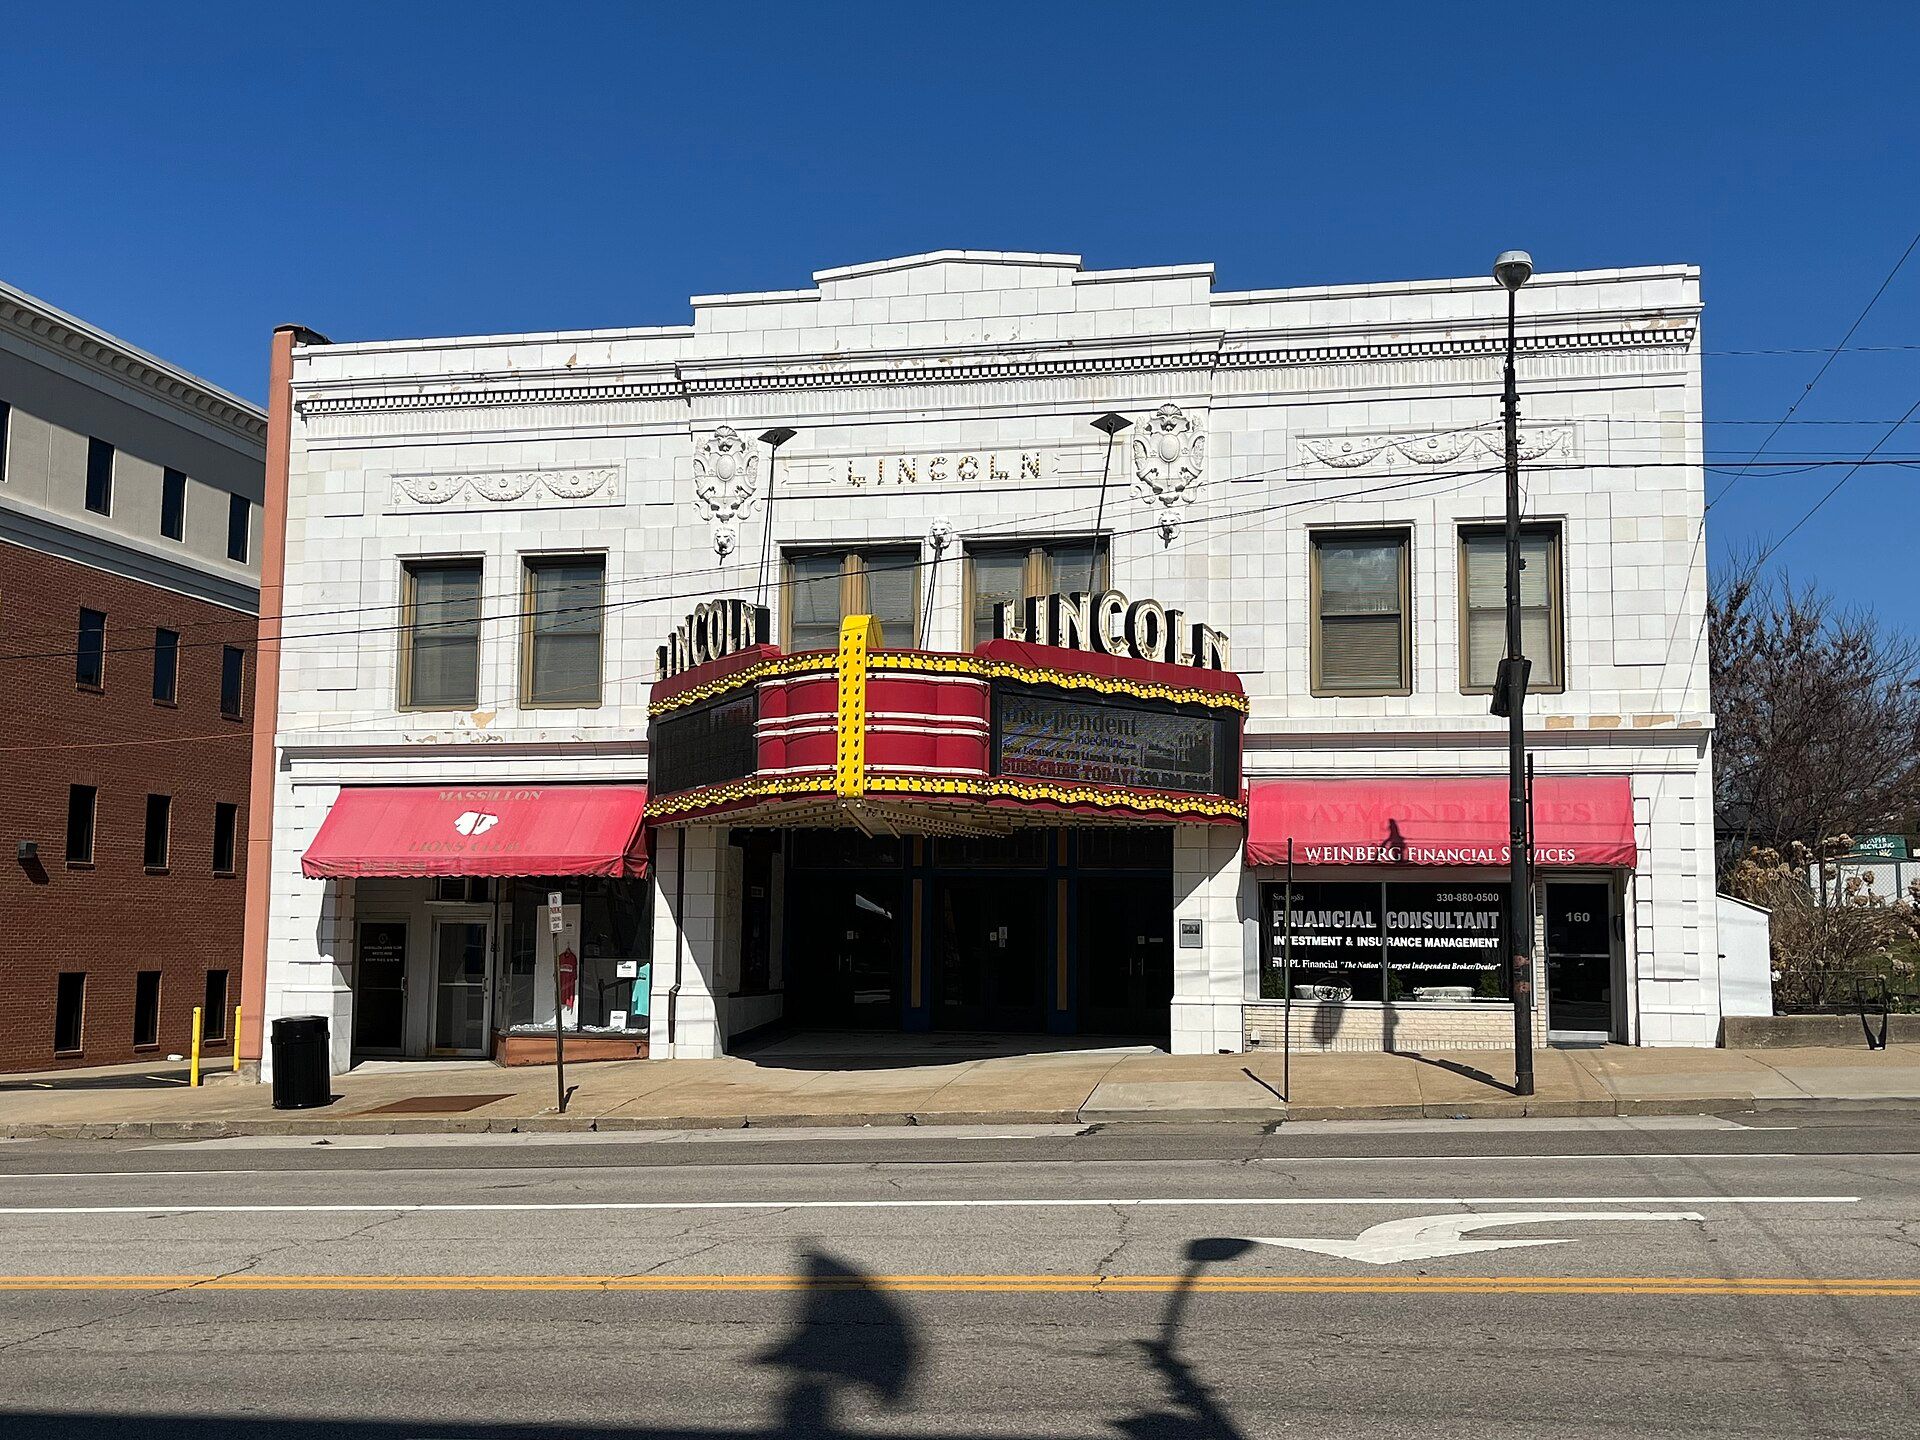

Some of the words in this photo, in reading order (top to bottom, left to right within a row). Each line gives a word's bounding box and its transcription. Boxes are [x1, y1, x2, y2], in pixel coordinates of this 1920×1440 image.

[847, 452, 1042, 487] LINCOLN
[993, 589, 1229, 672] LINCOLN
[655, 599, 769, 681] LINCOLN
[1003, 757, 1080, 779] SUBSCRIBE
[1084, 764, 1135, 785] TODAY!
[438, 790, 543, 801] MASSILLON
[1289, 804, 1466, 822] RAYMOND
[408, 840, 466, 853] LIONS
[1860, 842, 1895, 850] RECYCLING
[1304, 846, 1402, 861] WEINBERG
[1501, 847, 1576, 862] SVICES
[1273, 893, 1289, 901] Sinc
[1436, 893, 1499, 902] 330-880-0500
[1386, 911, 1499, 929] CONSULTANT
[1565, 912, 1591, 922] 160
[1273, 935, 1342, 946] INESTMENT
[1345, 937, 1353, 946] &
[1357, 937, 1422, 947] INSURANCE
[1424, 938, 1499, 948] MANAGEMENT
[1302, 960, 1338, 969] Financial
[1387, 962, 1411, 971] Largest
[1412, 962, 1451, 971] Independent
